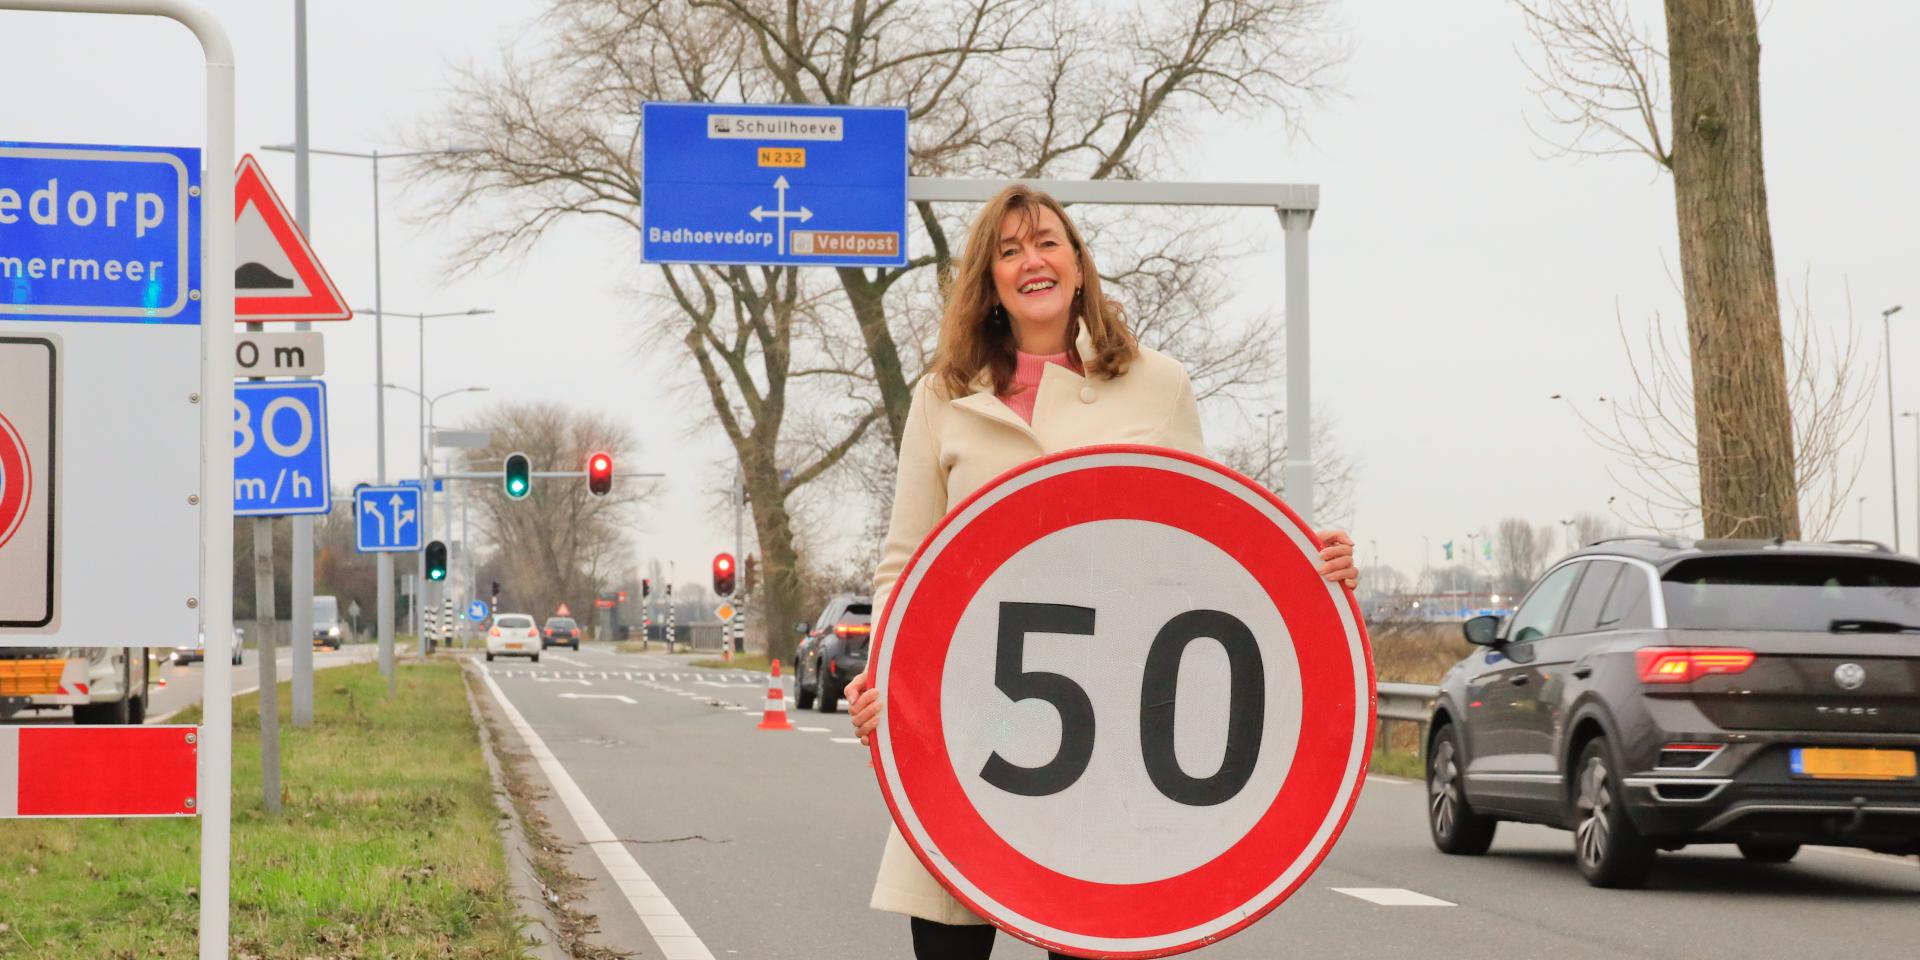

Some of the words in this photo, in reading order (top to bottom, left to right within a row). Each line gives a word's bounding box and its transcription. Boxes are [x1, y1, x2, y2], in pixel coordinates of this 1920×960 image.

[736, 119, 837, 134] Schuilhoeve
[762, 151, 770, 163] N
[774, 151, 801, 164] 232
[0, 178, 164, 238] edorp
[649, 227, 774, 247] Badhoevedorp
[817, 234, 894, 253] Veldpost
[0, 256, 164, 281] mermeer
[274, 346, 305, 368] m
[979, 601, 1266, 807] 50
